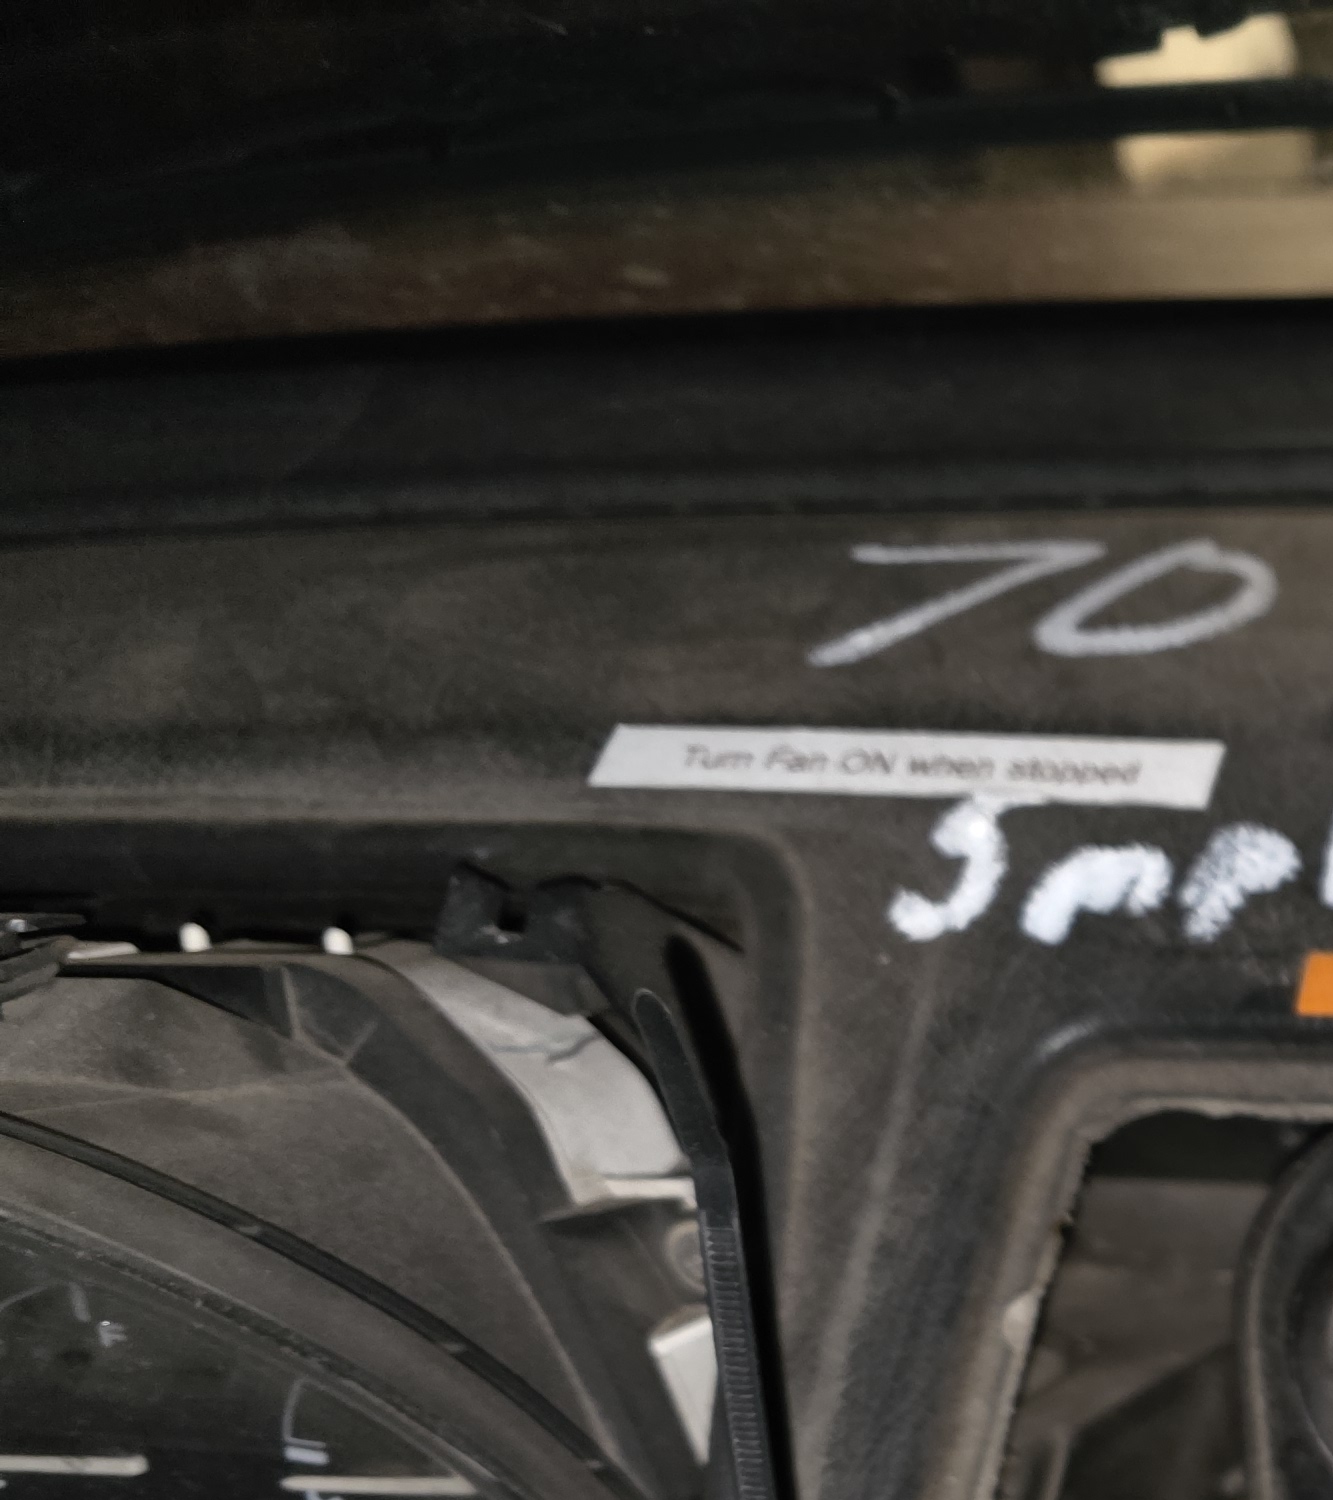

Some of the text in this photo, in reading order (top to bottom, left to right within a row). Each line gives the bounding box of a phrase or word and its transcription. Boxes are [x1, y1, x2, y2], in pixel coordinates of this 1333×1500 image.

[684, 743, 1144, 786] Turn Fan ON when stopped
